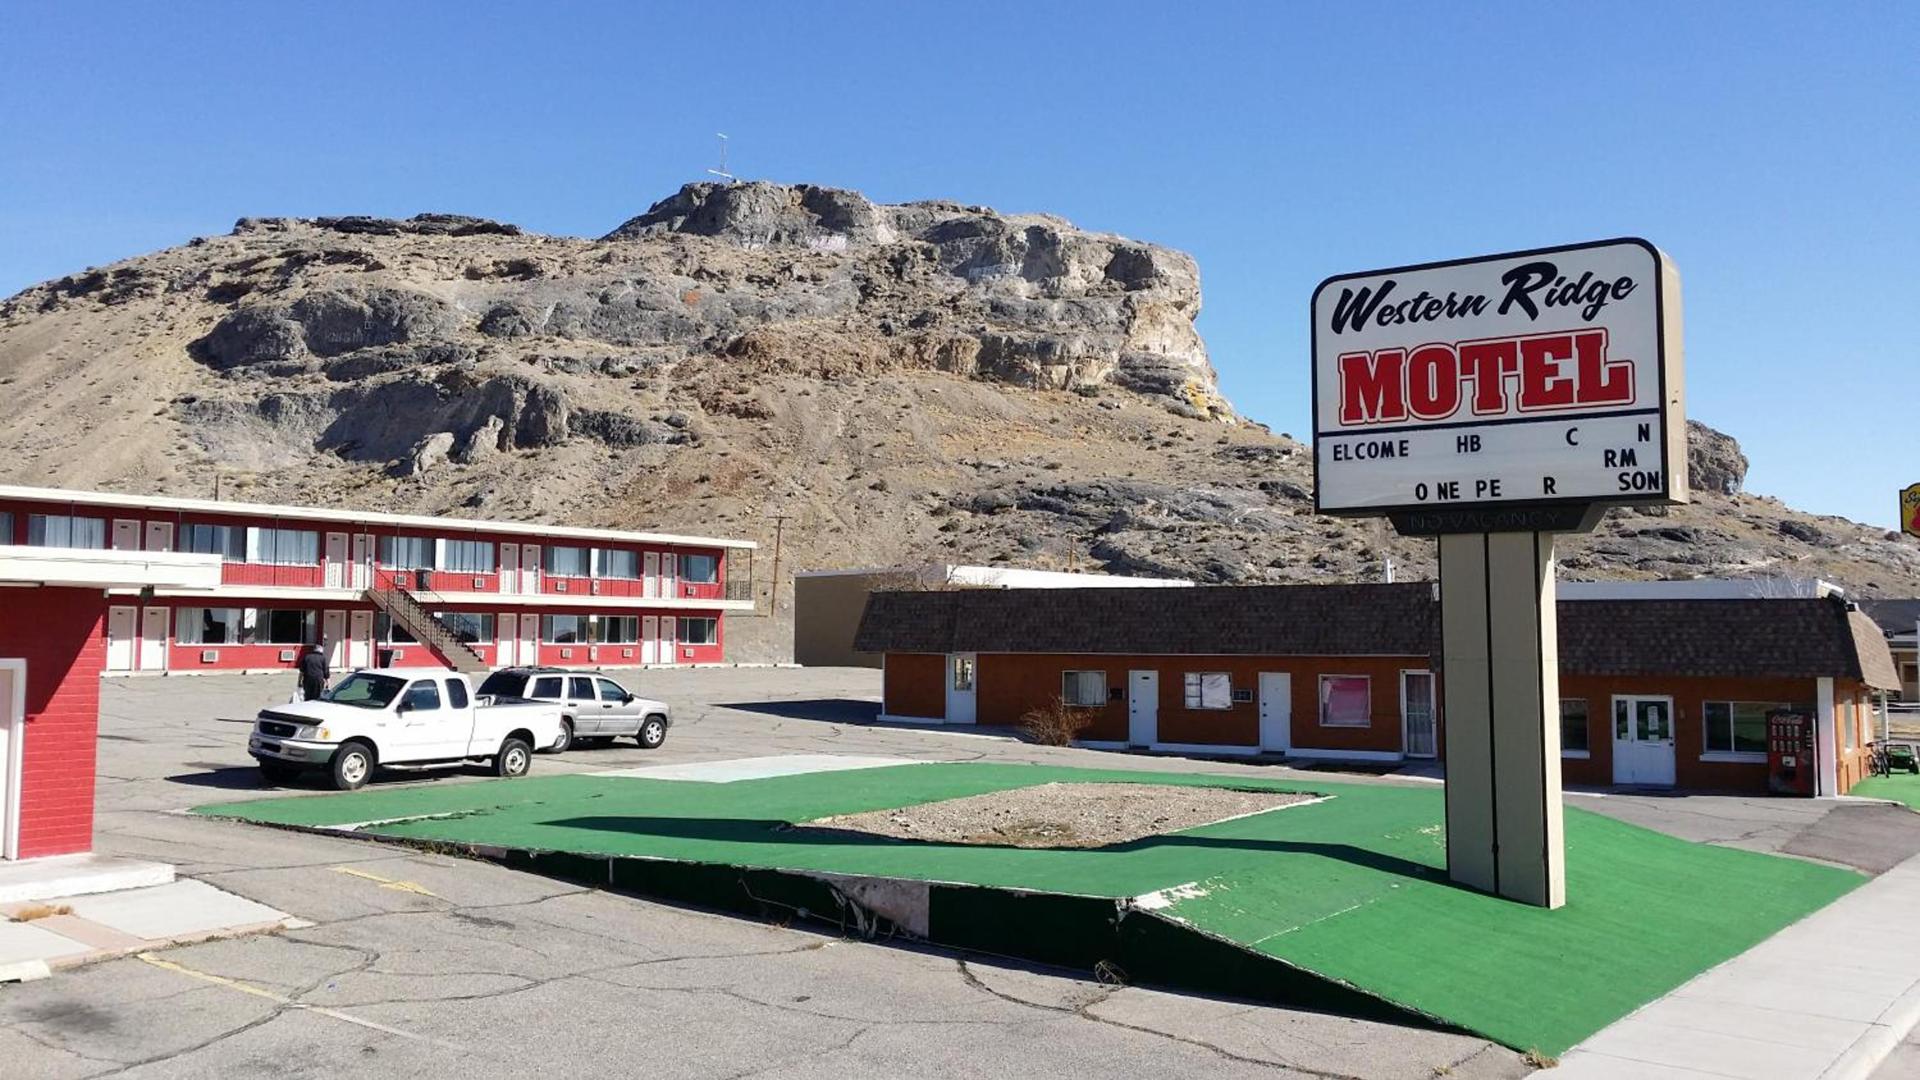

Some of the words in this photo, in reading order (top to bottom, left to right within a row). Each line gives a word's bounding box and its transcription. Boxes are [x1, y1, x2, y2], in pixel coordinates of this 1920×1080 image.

[1331, 280, 1492, 334] Western
[1497, 262, 1638, 322] Ridge
[1338, 327, 1635, 426] MOTEL
[1333, 440, 1409, 462] ELCOME
[1456, 435, 1482, 453] HB
[1566, 428, 1579, 446] C
[1638, 424, 1650, 442] N
[1604, 449, 1638, 468] RM
[1476, 480, 1501, 498] PE
[1543, 477, 1557, 495] R
[1618, 472, 1660, 492] SON
[1410, 513, 1443, 530] NO
[1450, 510, 1561, 529] VACANCY
